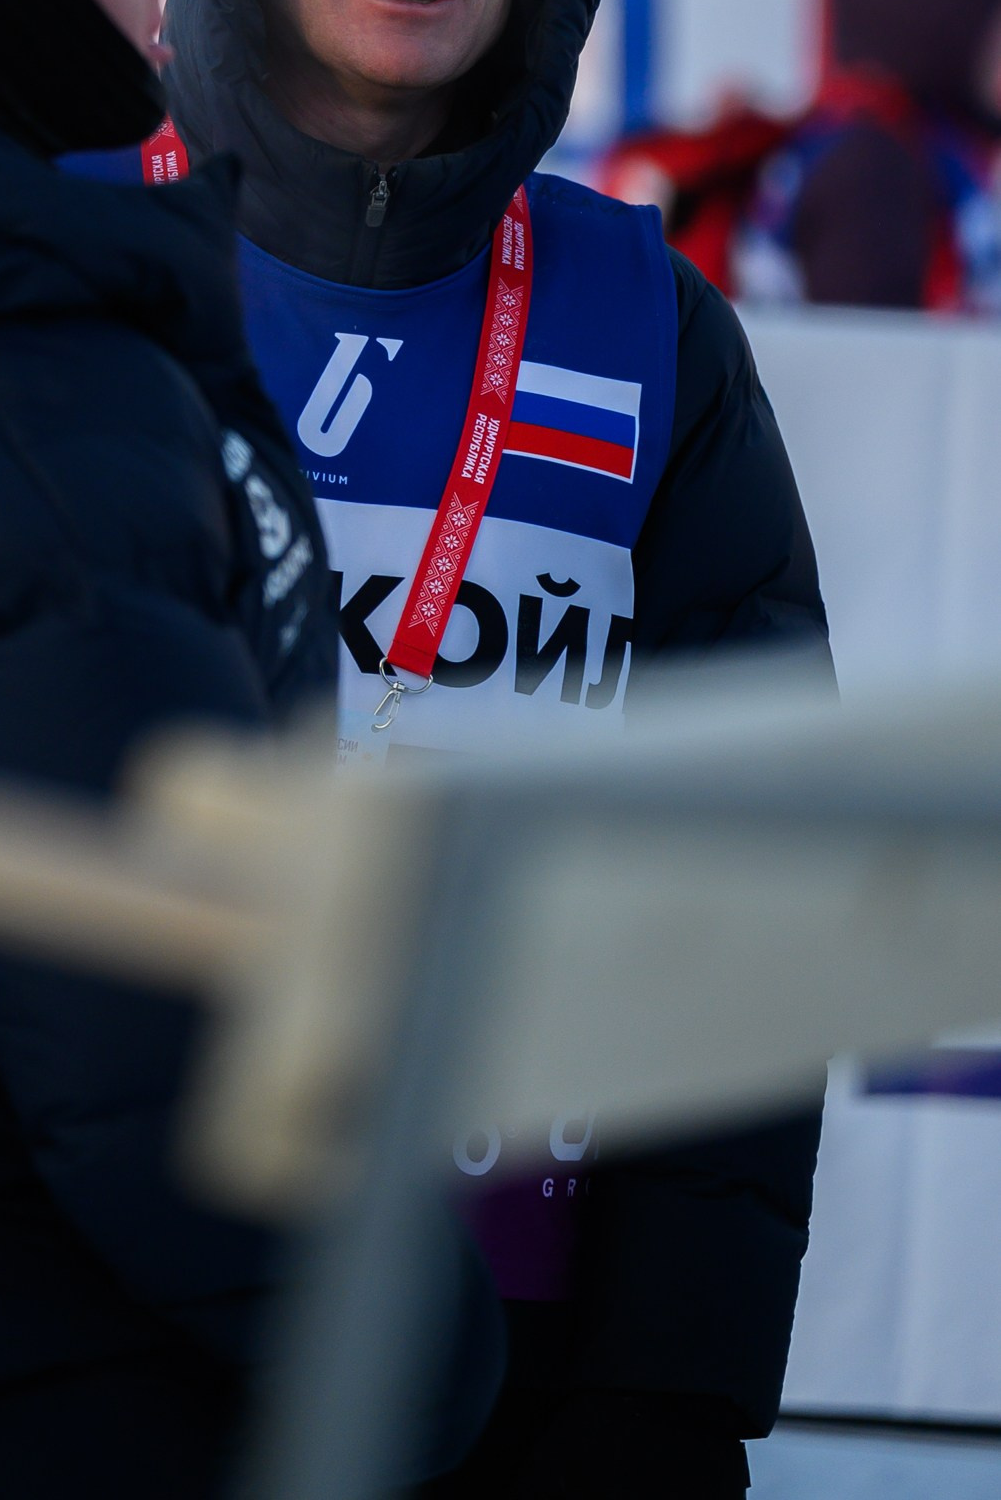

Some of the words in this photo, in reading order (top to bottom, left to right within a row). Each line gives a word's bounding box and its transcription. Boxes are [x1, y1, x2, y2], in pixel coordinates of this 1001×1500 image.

[502, 213, 513, 265] РЕСПУБЛИКА
[514, 220, 525, 272] УДМУРТСКАЯ
[460, 412, 488, 479] РЕСПУБЛИКА
[473, 417, 501, 485] УДМУРТСКАЯ
[301, 469, 349, 485] IVIUM
